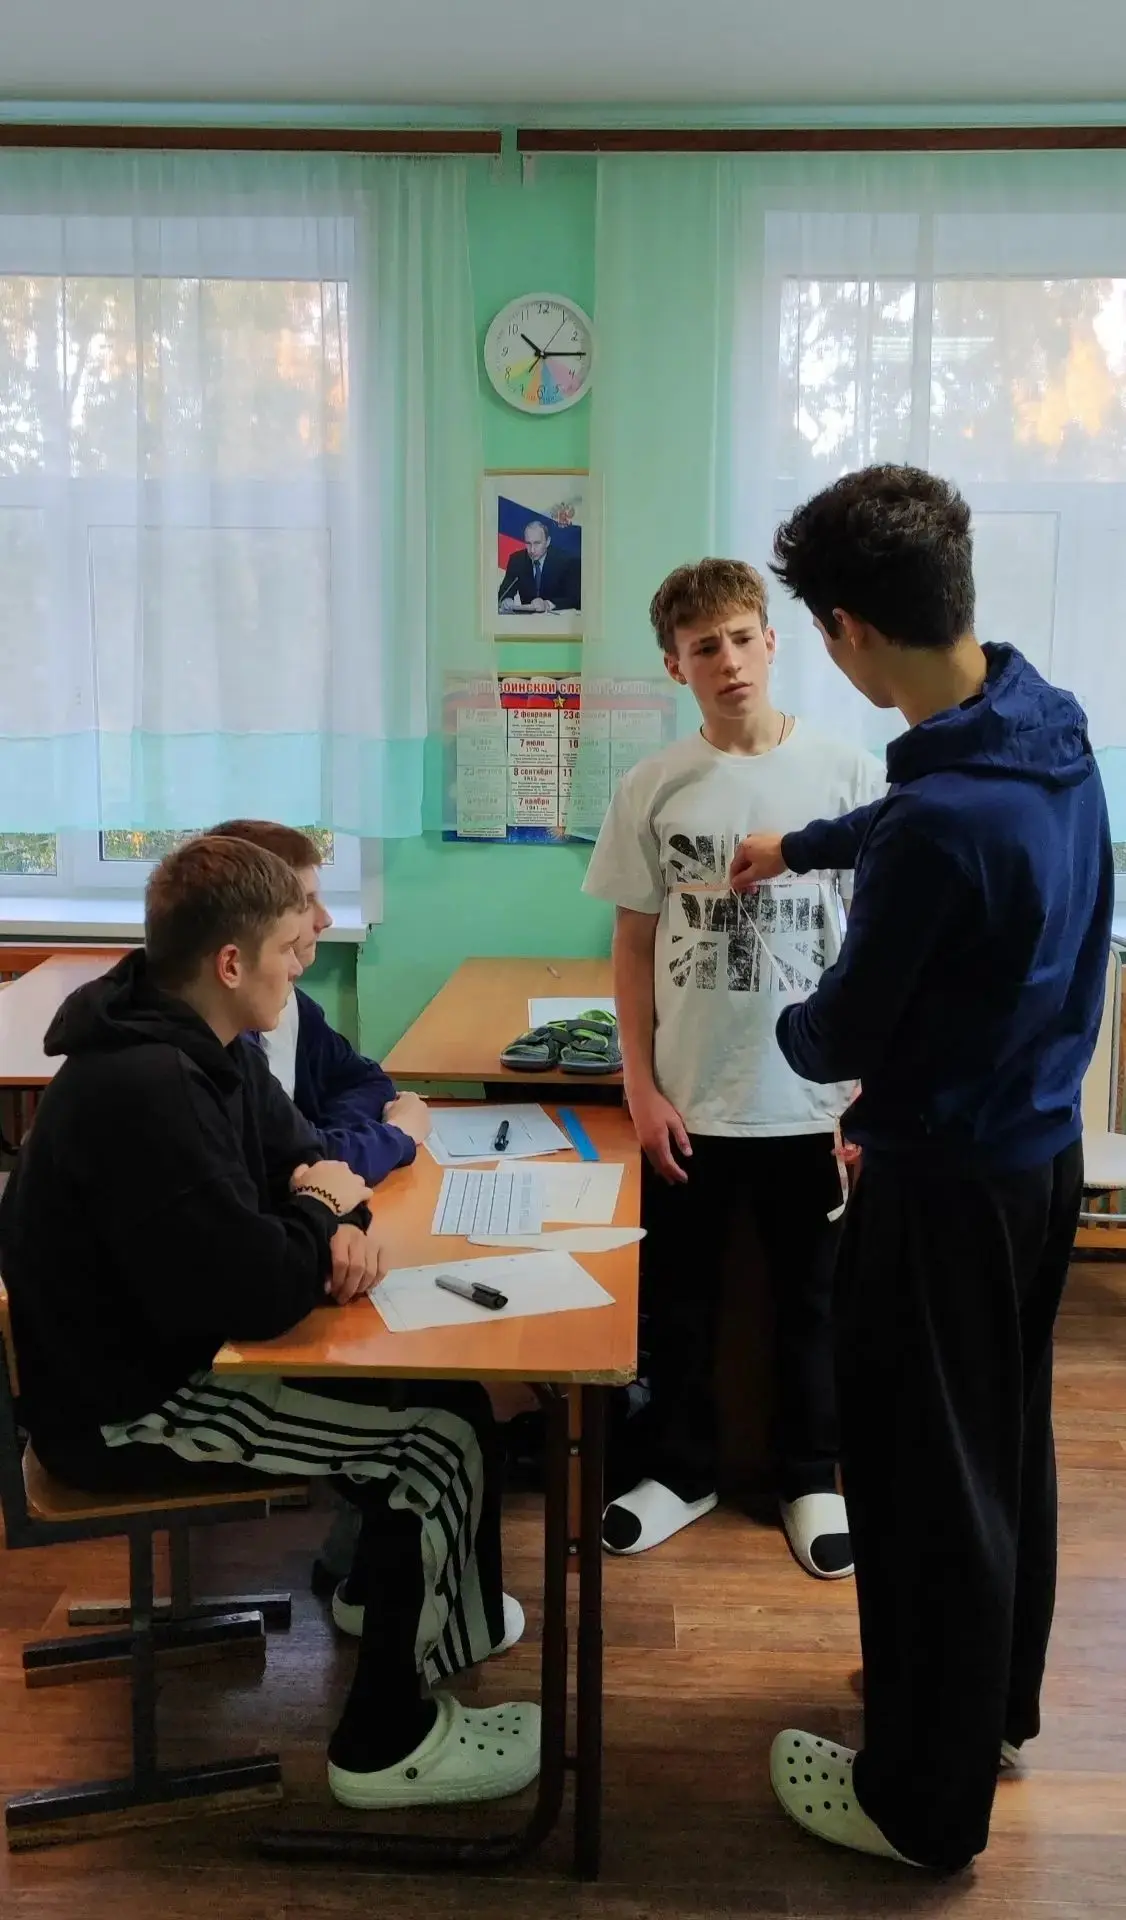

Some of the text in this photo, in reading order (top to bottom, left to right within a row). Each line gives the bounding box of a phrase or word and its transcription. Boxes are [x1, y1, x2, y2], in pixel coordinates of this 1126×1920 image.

[537, 303, 550, 314] 12
[521, 309, 529, 322] 11
[508, 323, 519, 335] 10
[571, 331, 578, 341] 2
[501, 347, 508, 357] 9
[505, 366, 512, 379] 8
[568, 369, 576, 377] 4
[537, 384, 545, 399] 6
[555, 384, 562, 394] 5
[513, 709, 552, 719] 2 февраля
[563, 710, 574, 720] 23
[519, 738, 525, 748] 7
[568, 739, 579, 749] 10
[513, 767, 553, 777] 8 сентября
[563, 768, 573, 778] 11
[518, 797, 550, 806] 7 ноября
